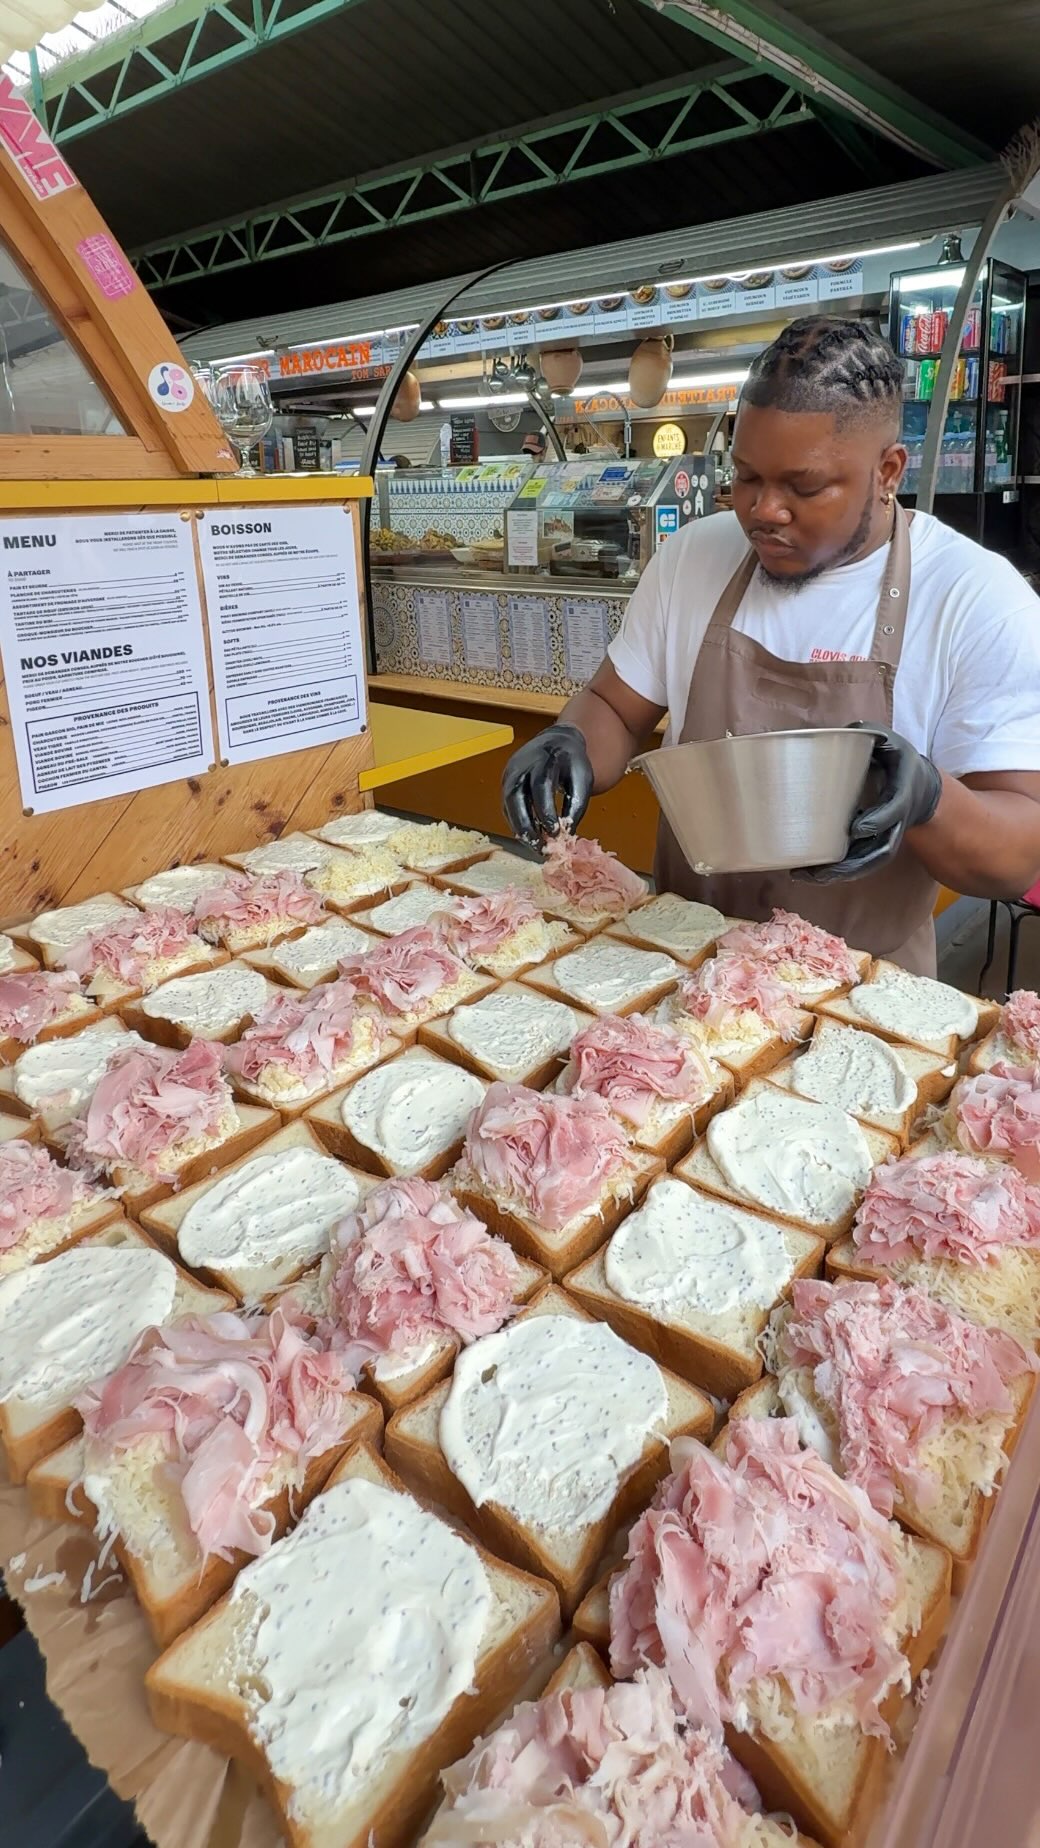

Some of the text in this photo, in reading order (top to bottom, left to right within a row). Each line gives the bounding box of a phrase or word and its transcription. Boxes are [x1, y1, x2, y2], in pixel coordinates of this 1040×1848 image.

[280, 341, 372, 377] MAROCAIN
[352, 370, 369, 380] TOM
[658, 433, 680, 443] ENFANTS
[660, 513, 676, 527] CB
[211, 522, 272, 536] BOISSON
[3, 534, 57, 549] MENU
[14, 569, 51, 577] PARTAGER
[20, 644, 133, 670] NOS VIANDES
[811, 648, 847, 662] CLOVIS
[268, 695, 299, 705] PROVENANCE
[74, 710, 115, 722] PROVENANCE
[130, 702, 159, 712] PRODUITS
[35, 750, 53, 758] VIANDE
[35, 757, 54, 765] VIANDE
[38, 776, 60, 784] COCHON
[61, 771, 81, 779] FERMIER
